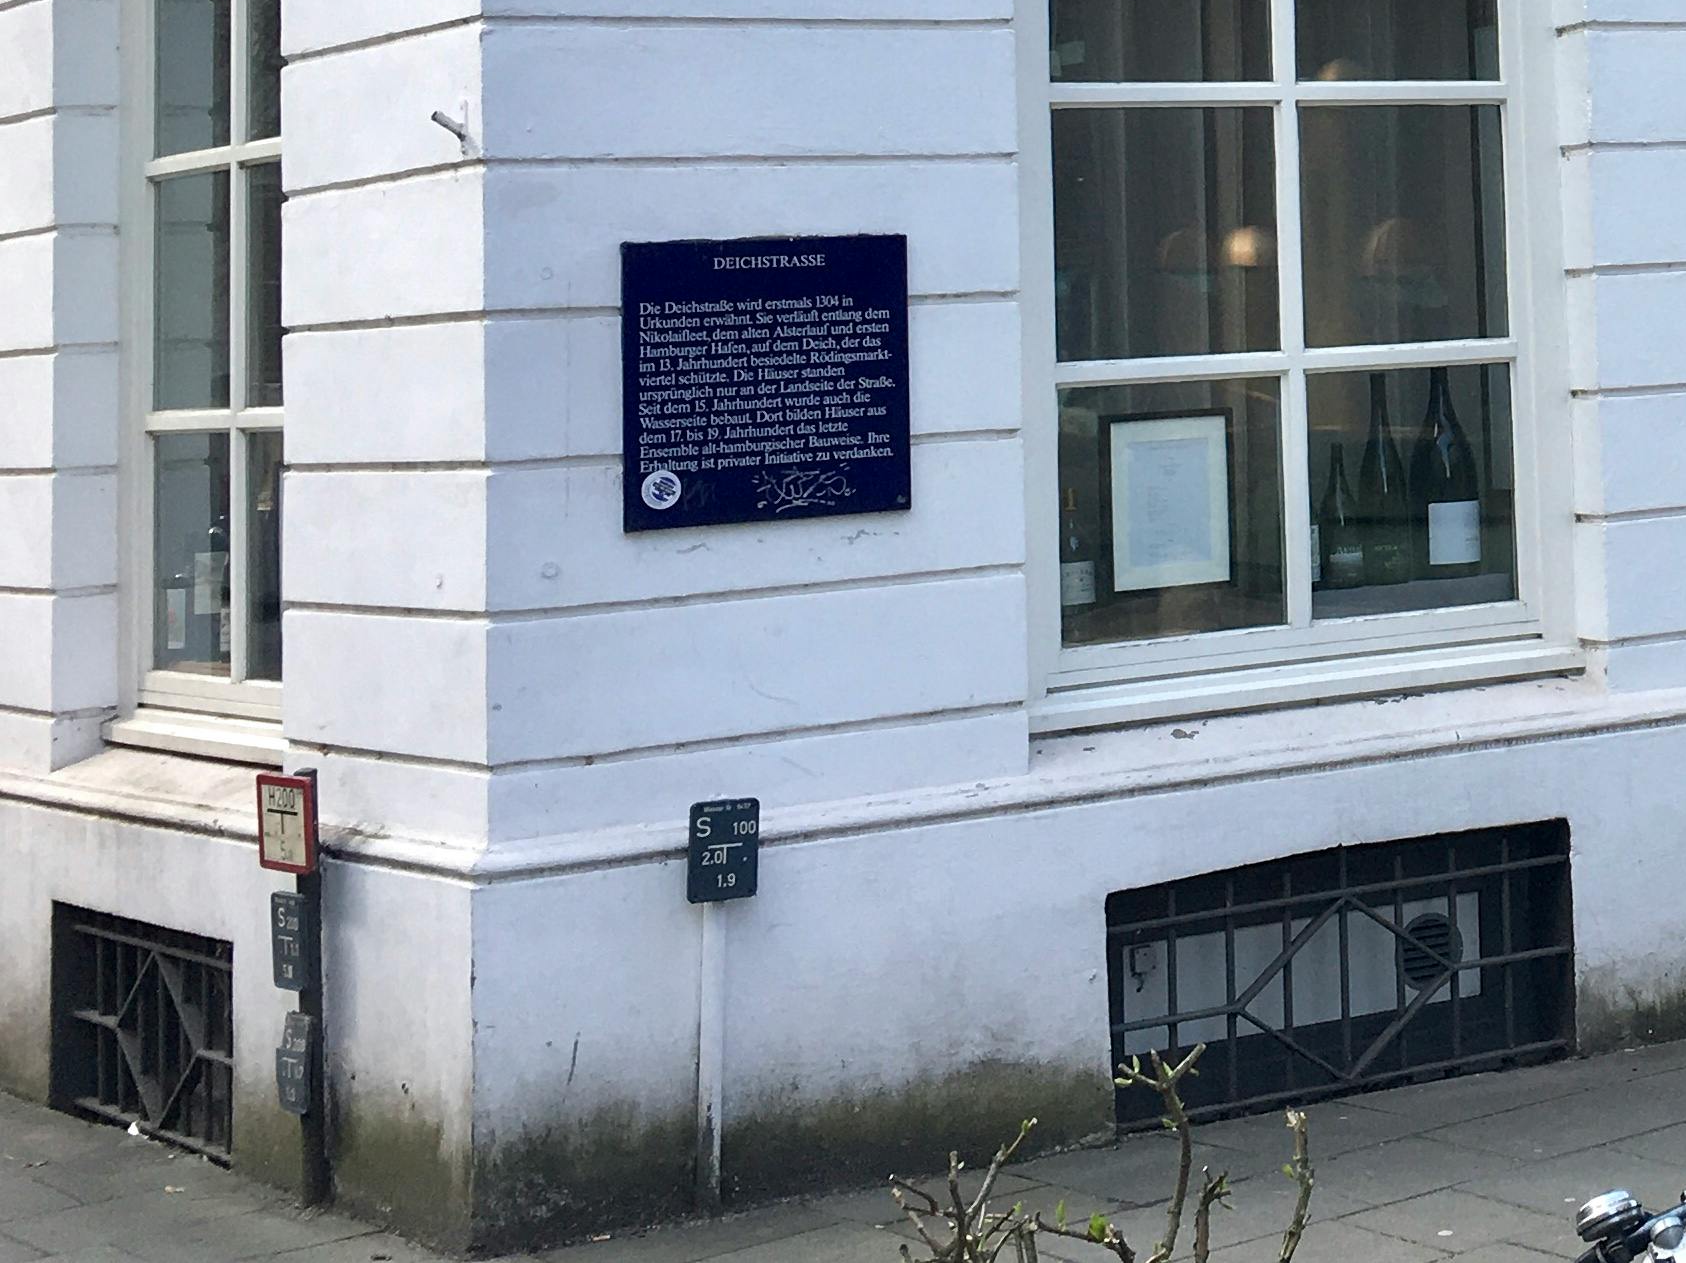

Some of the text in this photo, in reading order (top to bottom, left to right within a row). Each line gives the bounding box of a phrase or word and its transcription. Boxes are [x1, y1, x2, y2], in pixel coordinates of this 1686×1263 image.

[713, 254, 826, 270] DEICHSTRASSE
[640, 295, 853, 316] Die Deichstraße wird erstmals 1304 in
[640, 316, 701, 330] Urkunden
[756, 311, 774, 324] Sie
[776, 309, 819, 323] verläuft
[821, 309, 862, 322] entlang
[864, 307, 890, 319] dem
[639, 322, 890, 344] Nikolaifleet, dem alten Alsterlauf und ersten
[640, 336, 881, 358] Hamburger Hafen, auf dem Deich, der das
[639, 348, 893, 373] im 13. Jahrhundert besiedelte Rödingsmarkt-
[639, 365, 845, 386] viertel schützte. Die Häuser standen
[639, 375, 896, 402] ursprünglich nur an der Landseite der Straße.
[638, 390, 871, 416] Seit dem 15. Jahrhundert wurde auch die
[640, 415, 708, 429] Wasserseite
[756, 410, 784, 423] Dort
[785, 408, 822, 421] bilden
[824, 405, 865, 418] Häuser
[867, 405, 887, 416] aus
[639, 421, 849, 444] dem 17. bis 19. Jahrhundert das letzte
[640, 431, 890, 459] Ensemble alt-hamburgischer Bauweise. Ihre
[640, 458, 699, 473] Erhaltung
[701, 456, 716, 469] ist
[718, 455, 761, 470] privater
[764, 449, 814, 464] Initiative
[815, 451, 831, 461] zu
[268, 786, 295, 809] H200
[696, 816, 757, 838] S 100
[702, 850, 722, 866] 2.0
[717, 873, 736, 888] 1.9
